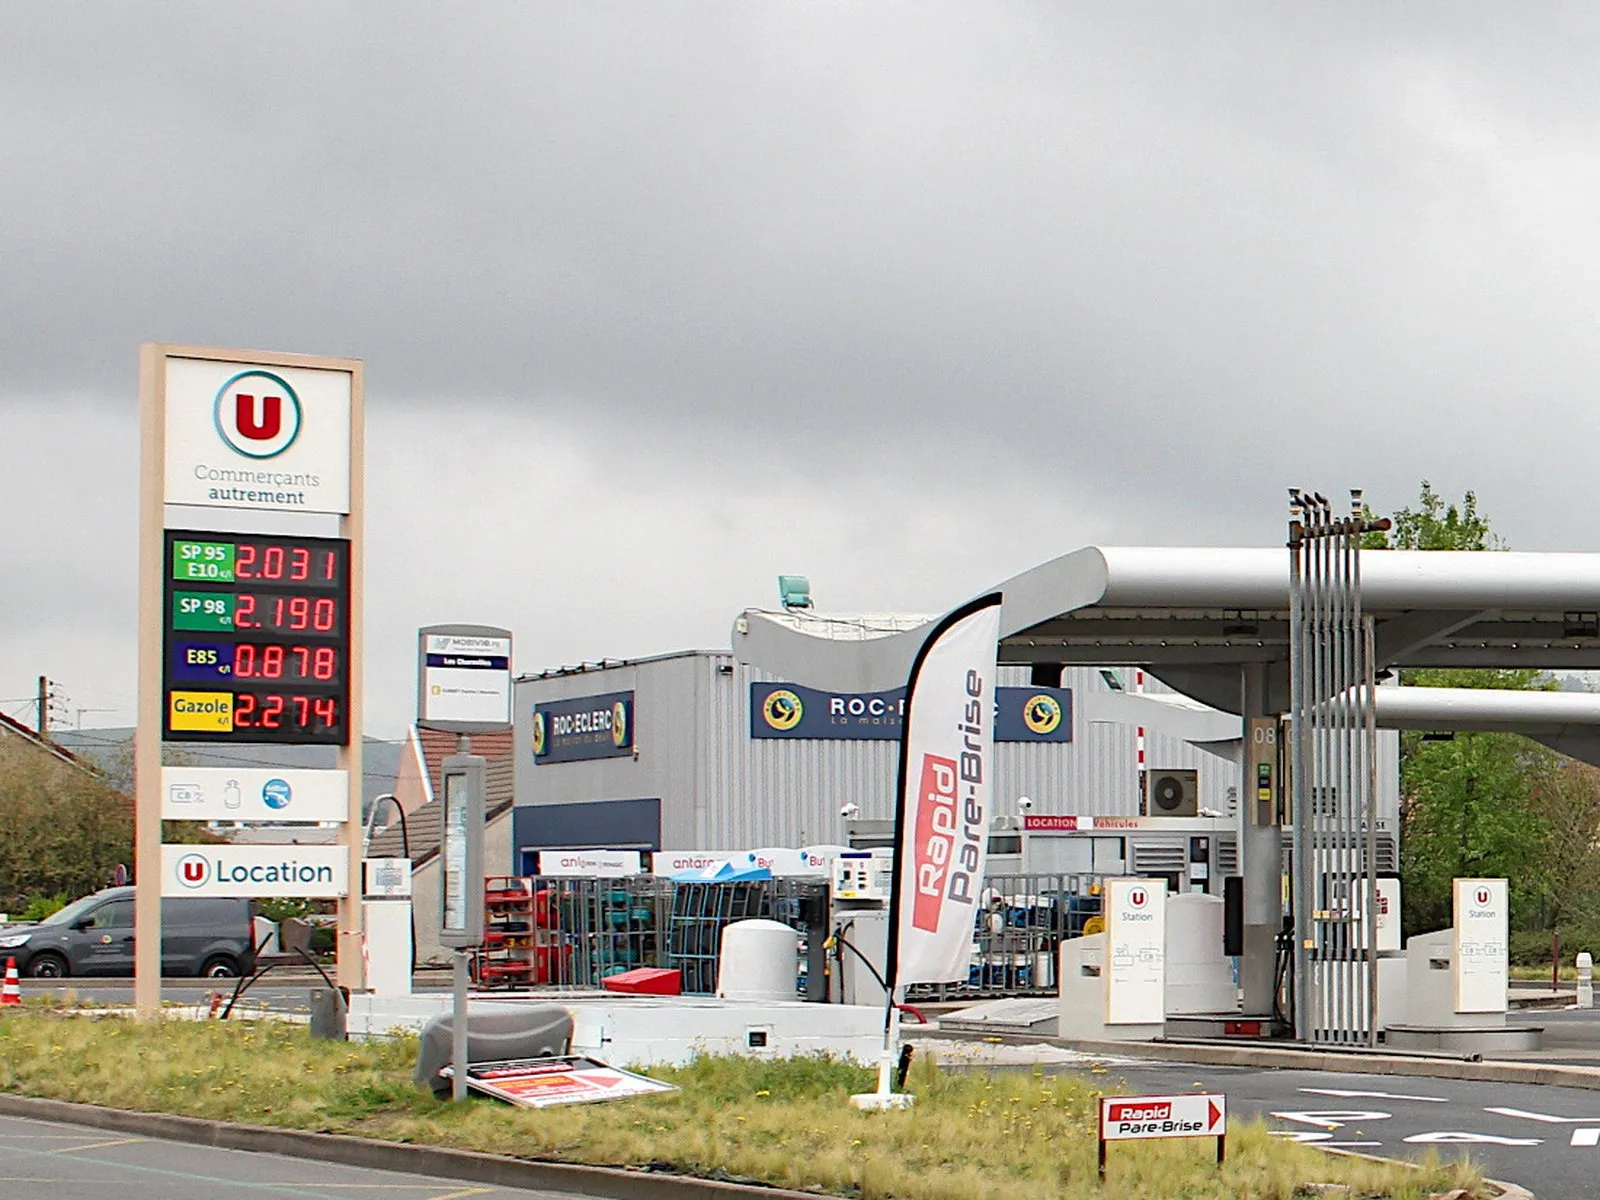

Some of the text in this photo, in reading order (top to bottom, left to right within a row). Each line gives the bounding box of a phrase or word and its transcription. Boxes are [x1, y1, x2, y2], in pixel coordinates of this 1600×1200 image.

[236, 394, 281, 440] U
[194, 465, 320, 487] Commerçants
[208, 487, 305, 504] autrement
[180, 545, 226, 561] SP 95
[187, 563, 219, 578] E10
[235, 545, 335, 581] 2.031
[180, 598, 226, 615] SP 98
[234, 595, 335, 631] 2.190
[186, 649, 217, 664] E85
[234, 644, 335, 680] 0.878
[174, 698, 229, 713] Gazole
[234, 693, 335, 728] 2.274
[1254, 727, 1276, 744] 08
[947, 669, 983, 905] Pare-Brise
[919, 763, 956, 897] Rapid
[1027, 817, 1077, 828] LOCATION
[184, 860, 332, 883] U Location
[1132, 892, 1145, 905] U
[1477, 891, 1488, 903] U
[1122, 912, 1153, 922] Station
[1468, 910, 1496, 919] Station
[1120, 1105, 1170, 1120] Rapid
[1119, 1119, 1203, 1134] Pare-Brise
